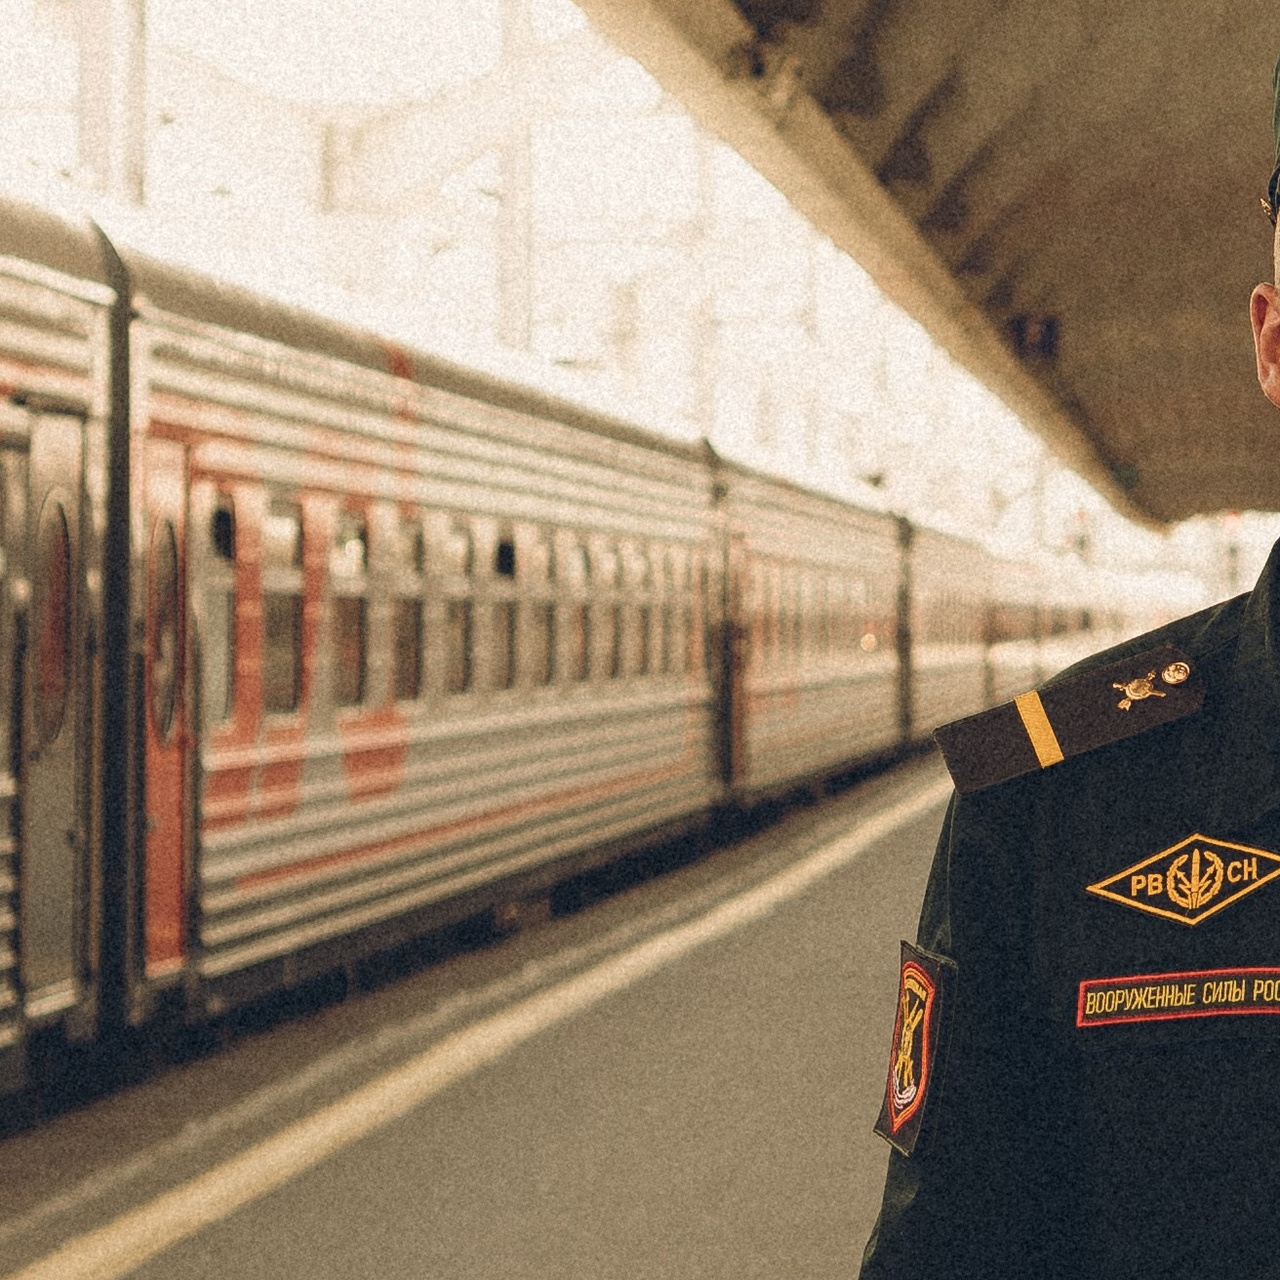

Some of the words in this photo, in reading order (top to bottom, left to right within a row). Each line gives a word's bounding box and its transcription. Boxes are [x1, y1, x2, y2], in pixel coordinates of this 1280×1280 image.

[1131, 874, 1163, 896] РВ
[1227, 858, 1258, 883] СН
[1085, 983, 1197, 1015] ВООРУЖЕННЫЕ
[1202, 979, 1246, 1004] СИЛЫ
